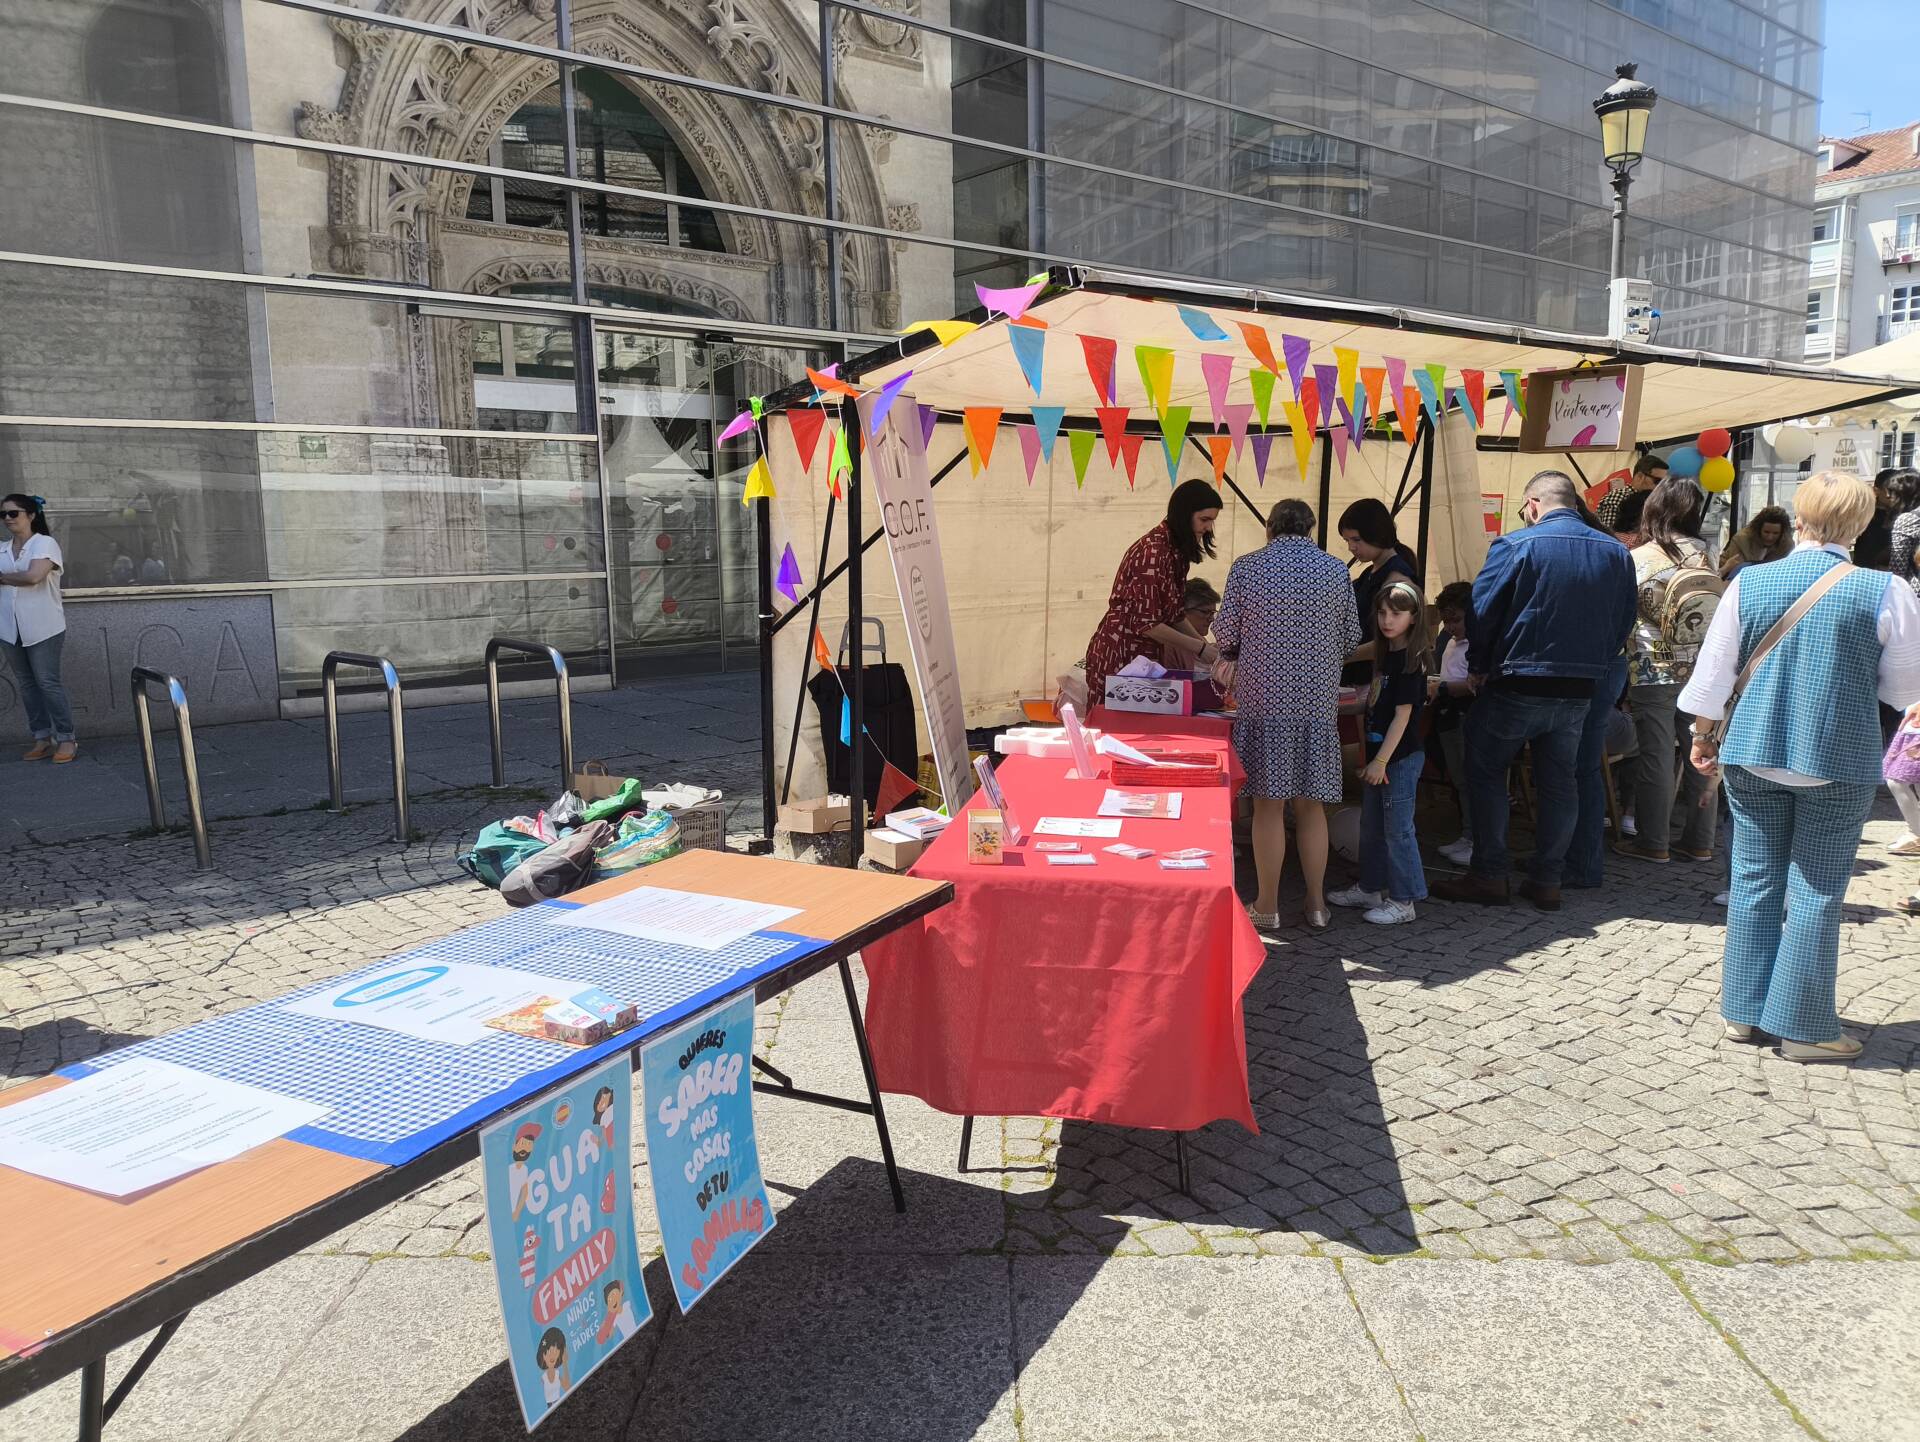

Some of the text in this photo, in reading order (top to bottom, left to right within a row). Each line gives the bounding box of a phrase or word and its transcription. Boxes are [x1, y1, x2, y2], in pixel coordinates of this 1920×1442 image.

[1832, 456, 1858, 467] NBM
[883, 498, 930, 539] C.O.F.
[678, 1029, 727, 1071] QUIERES
[658, 1052, 744, 1138] SABER
[690, 1104, 719, 1142] MAS
[524, 1128, 600, 1216] GUA
[684, 1131, 732, 1184] COSAS
[547, 1192, 592, 1252] TA
[681, 1195, 764, 1291] FAMILIA
[537, 1230, 609, 1321] FAMILY
[566, 1290, 596, 1327] NIÑOS
[571, 1319, 601, 1354] PADRES
